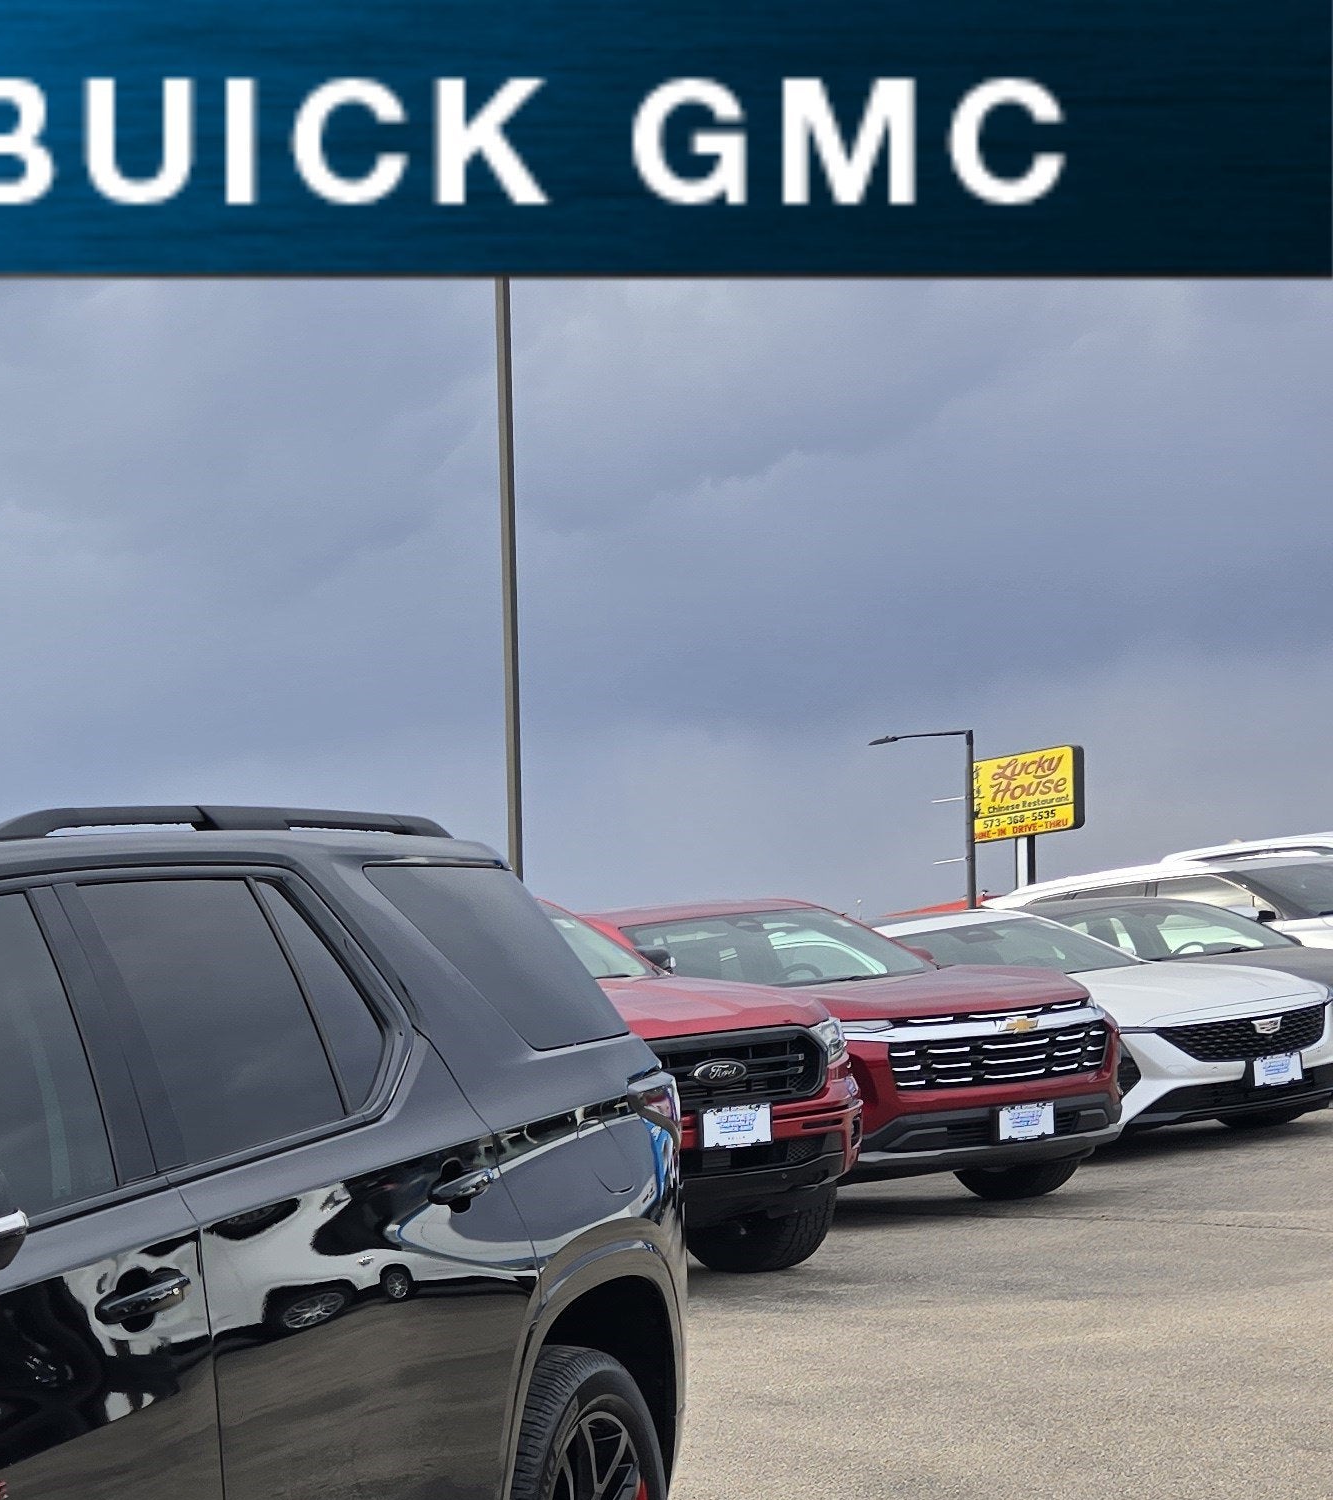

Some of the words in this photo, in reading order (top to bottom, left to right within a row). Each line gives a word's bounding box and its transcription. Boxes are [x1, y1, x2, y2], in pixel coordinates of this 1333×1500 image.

[992, 754, 1065, 780] Lucky
[989, 777, 1067, 804] House
[988, 803, 1020, 814] Chinese
[1022, 794, 1070, 808] Restaurant
